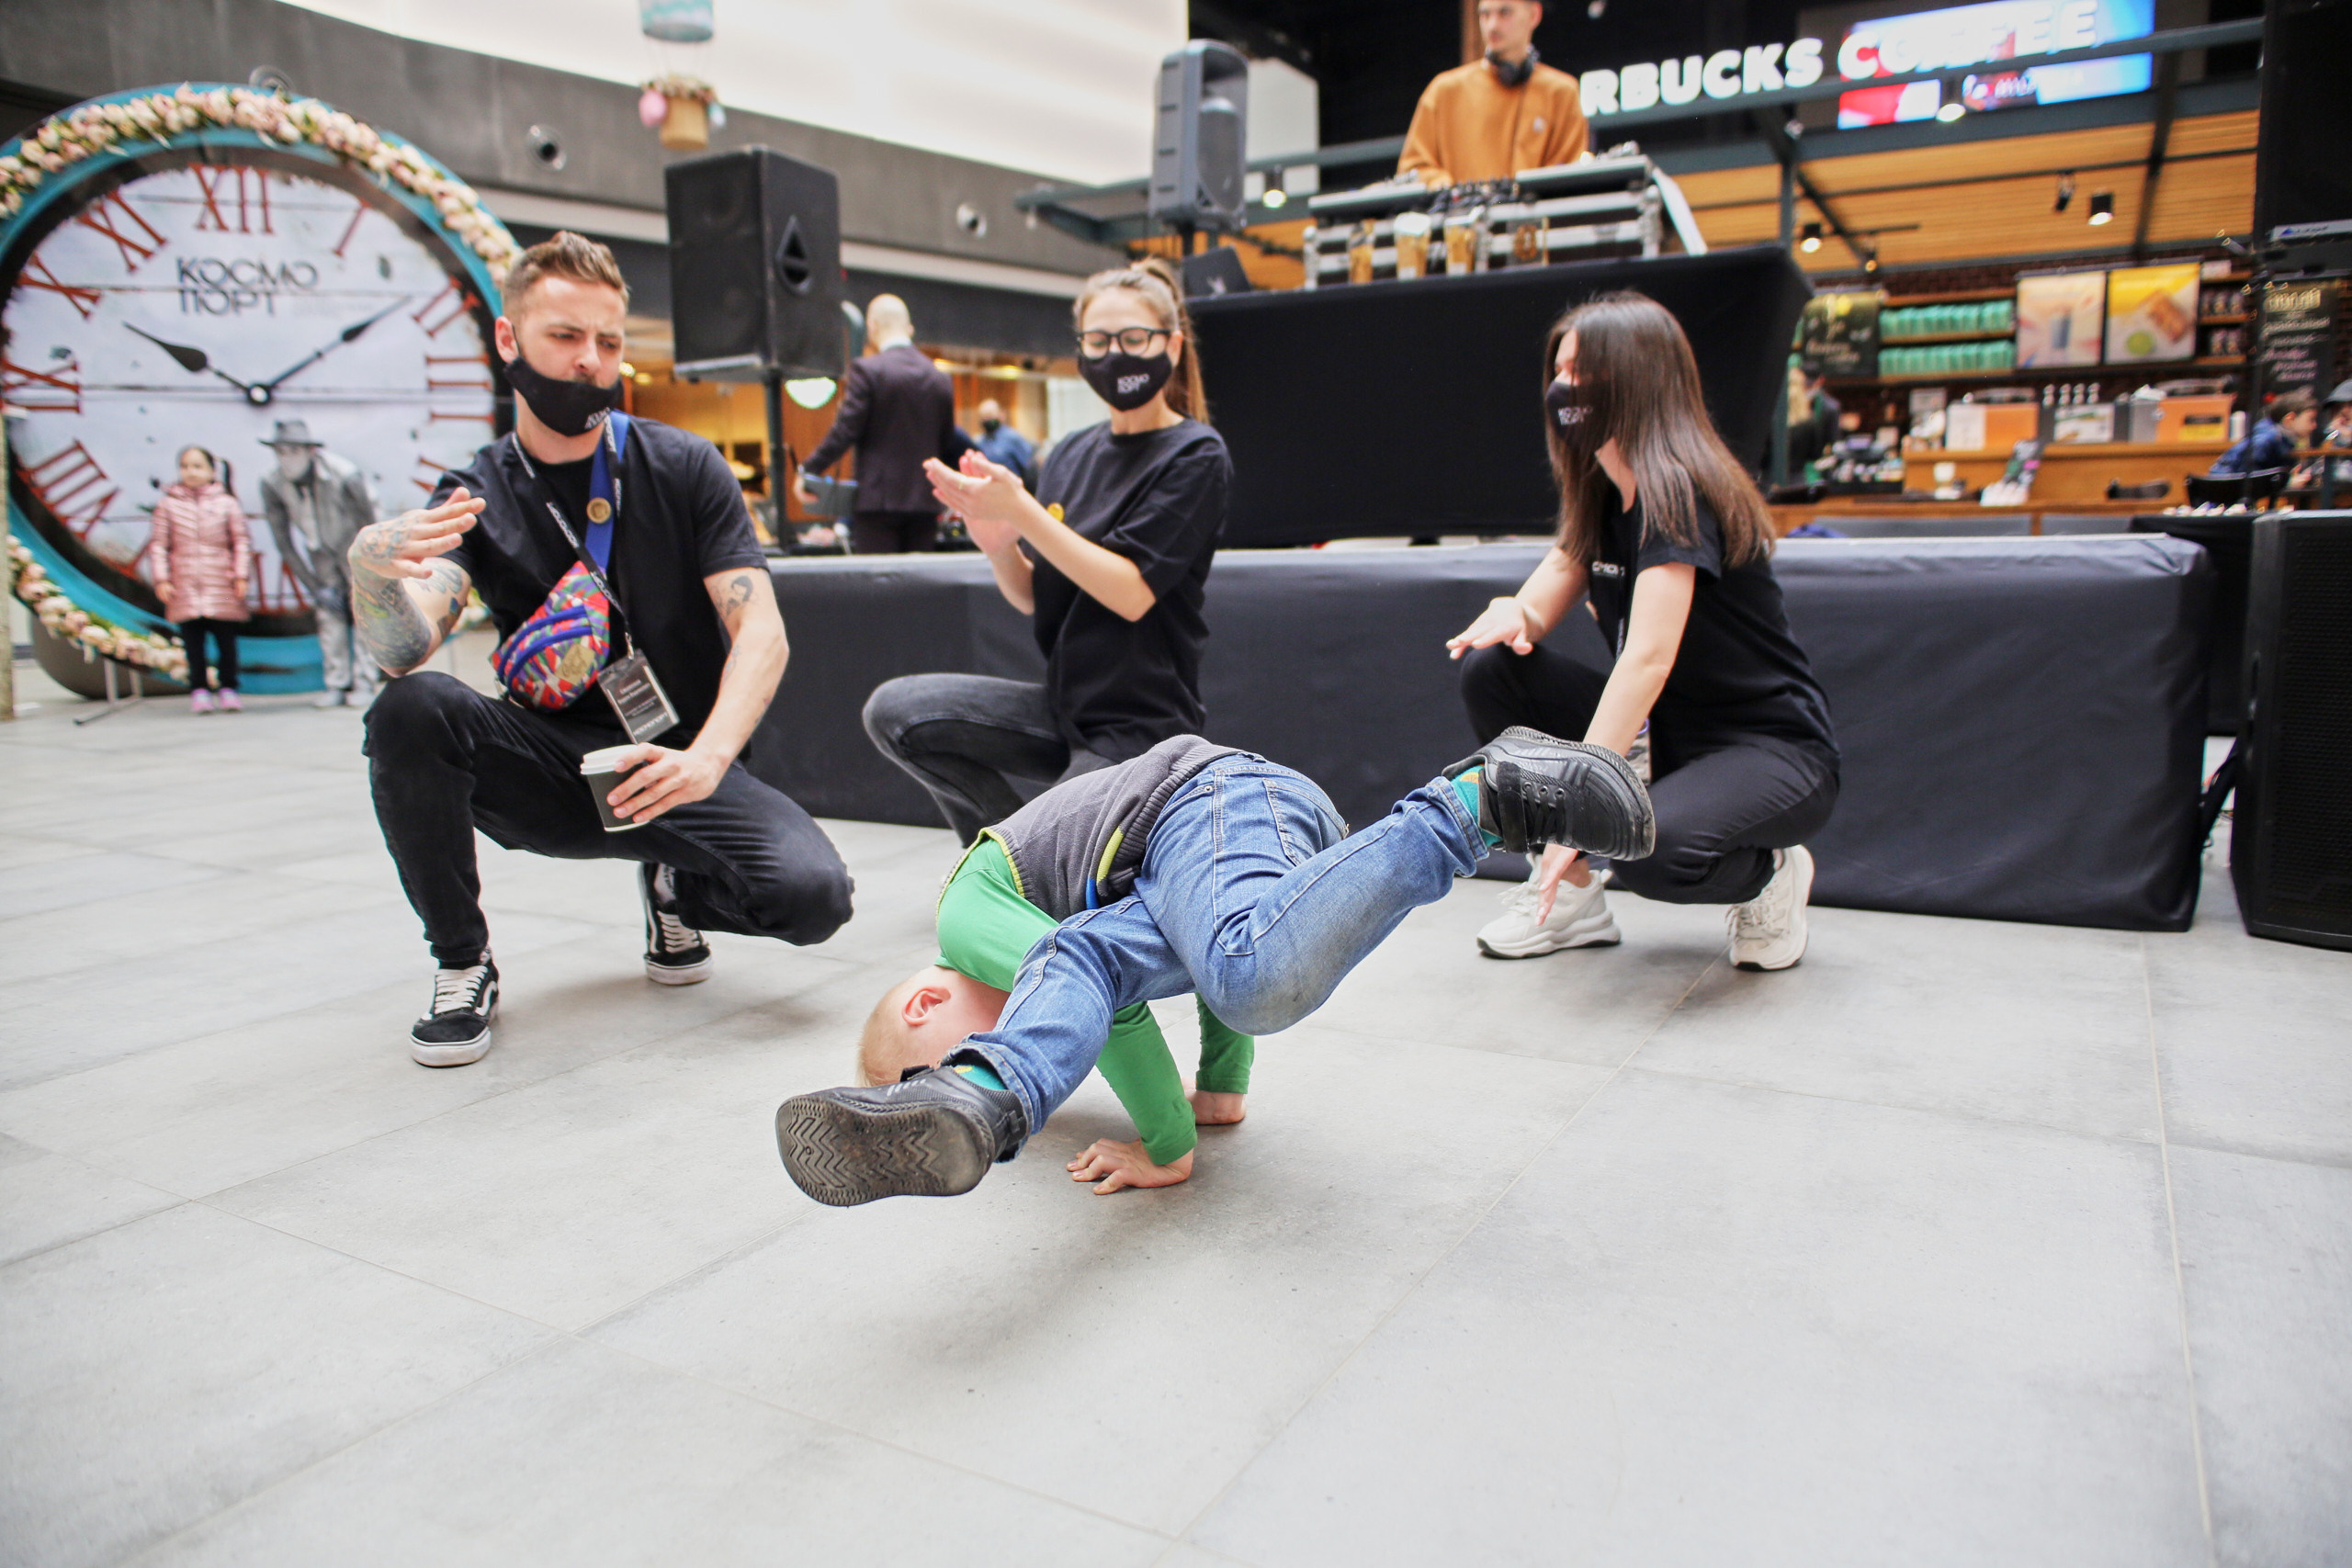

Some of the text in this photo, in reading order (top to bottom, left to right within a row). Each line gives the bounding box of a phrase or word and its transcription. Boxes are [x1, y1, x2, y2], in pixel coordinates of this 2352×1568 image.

[1579, 38, 1824, 118] RBUCKS
[188, 163, 277, 233] XII
[176, 256, 319, 288] КОСМО
[178, 288, 274, 315] ПОРТ
